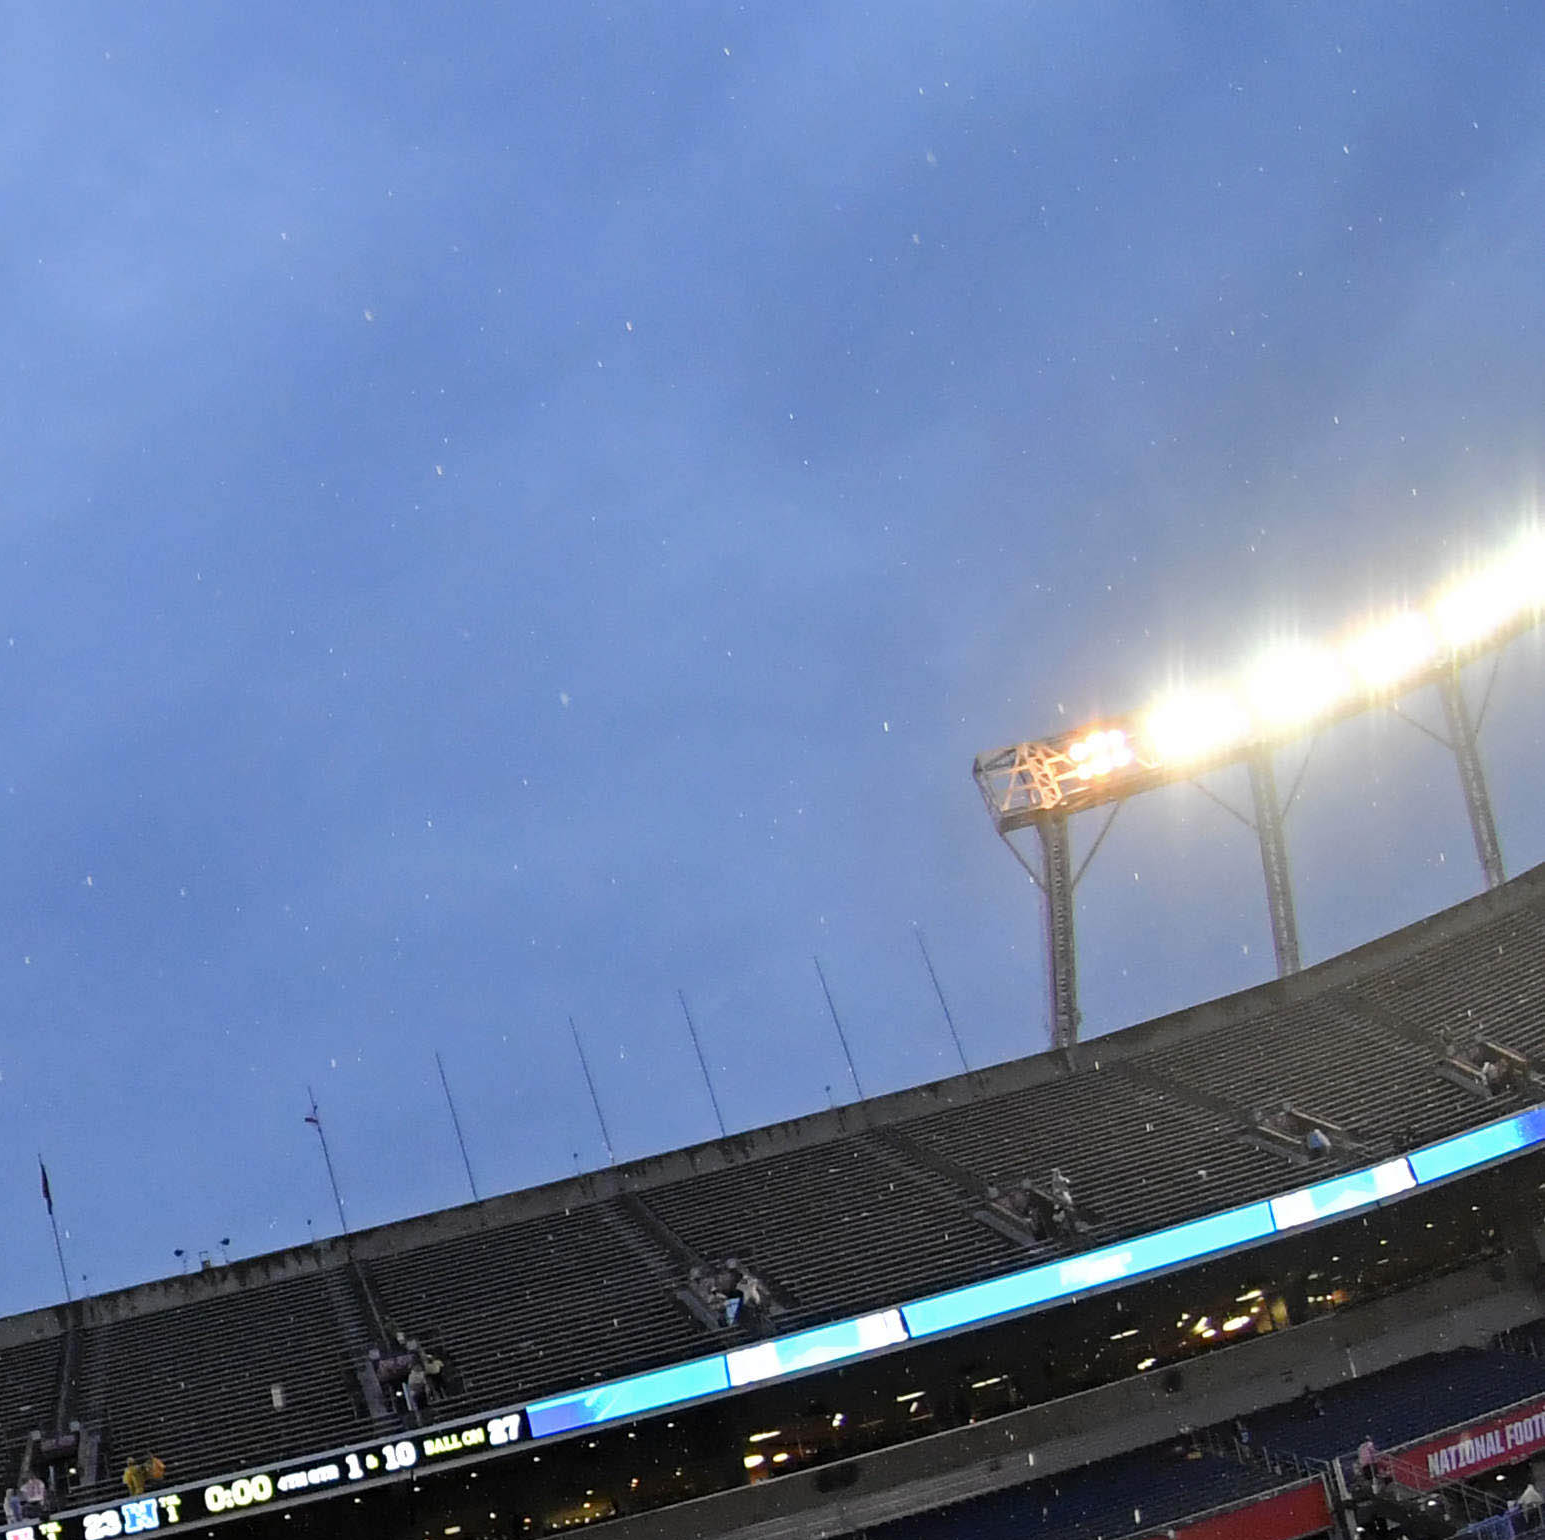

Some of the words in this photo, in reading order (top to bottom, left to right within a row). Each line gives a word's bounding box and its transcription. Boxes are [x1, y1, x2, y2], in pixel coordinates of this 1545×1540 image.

[204, 1474, 273, 1513] 0:00
[345, 1453, 363, 1480] 1
[381, 1440, 417, 1472] 10
[423, 1434, 462, 1457] BALL
[486, 1413, 521, 1446] 27
[1426, 1429, 1506, 1479] NATIONAL
